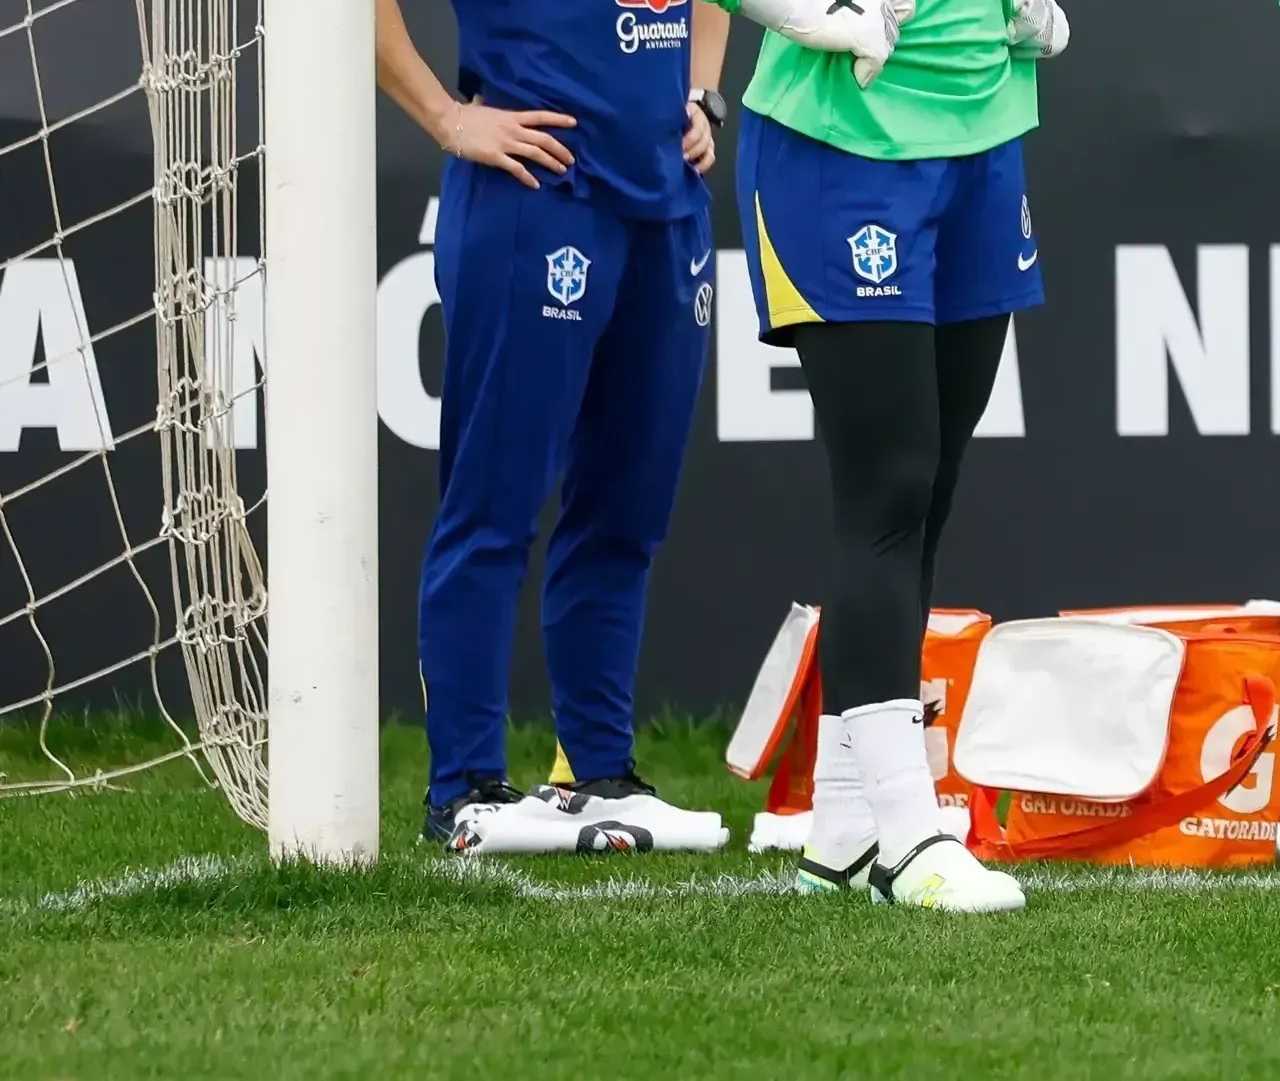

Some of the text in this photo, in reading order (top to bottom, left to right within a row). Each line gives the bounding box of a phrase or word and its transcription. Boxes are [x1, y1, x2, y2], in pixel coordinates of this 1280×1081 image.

[616, 11, 688, 54] Guaraná
[856, 286, 902, 297] BRASIL
[542, 305, 582, 321] BRASIL
